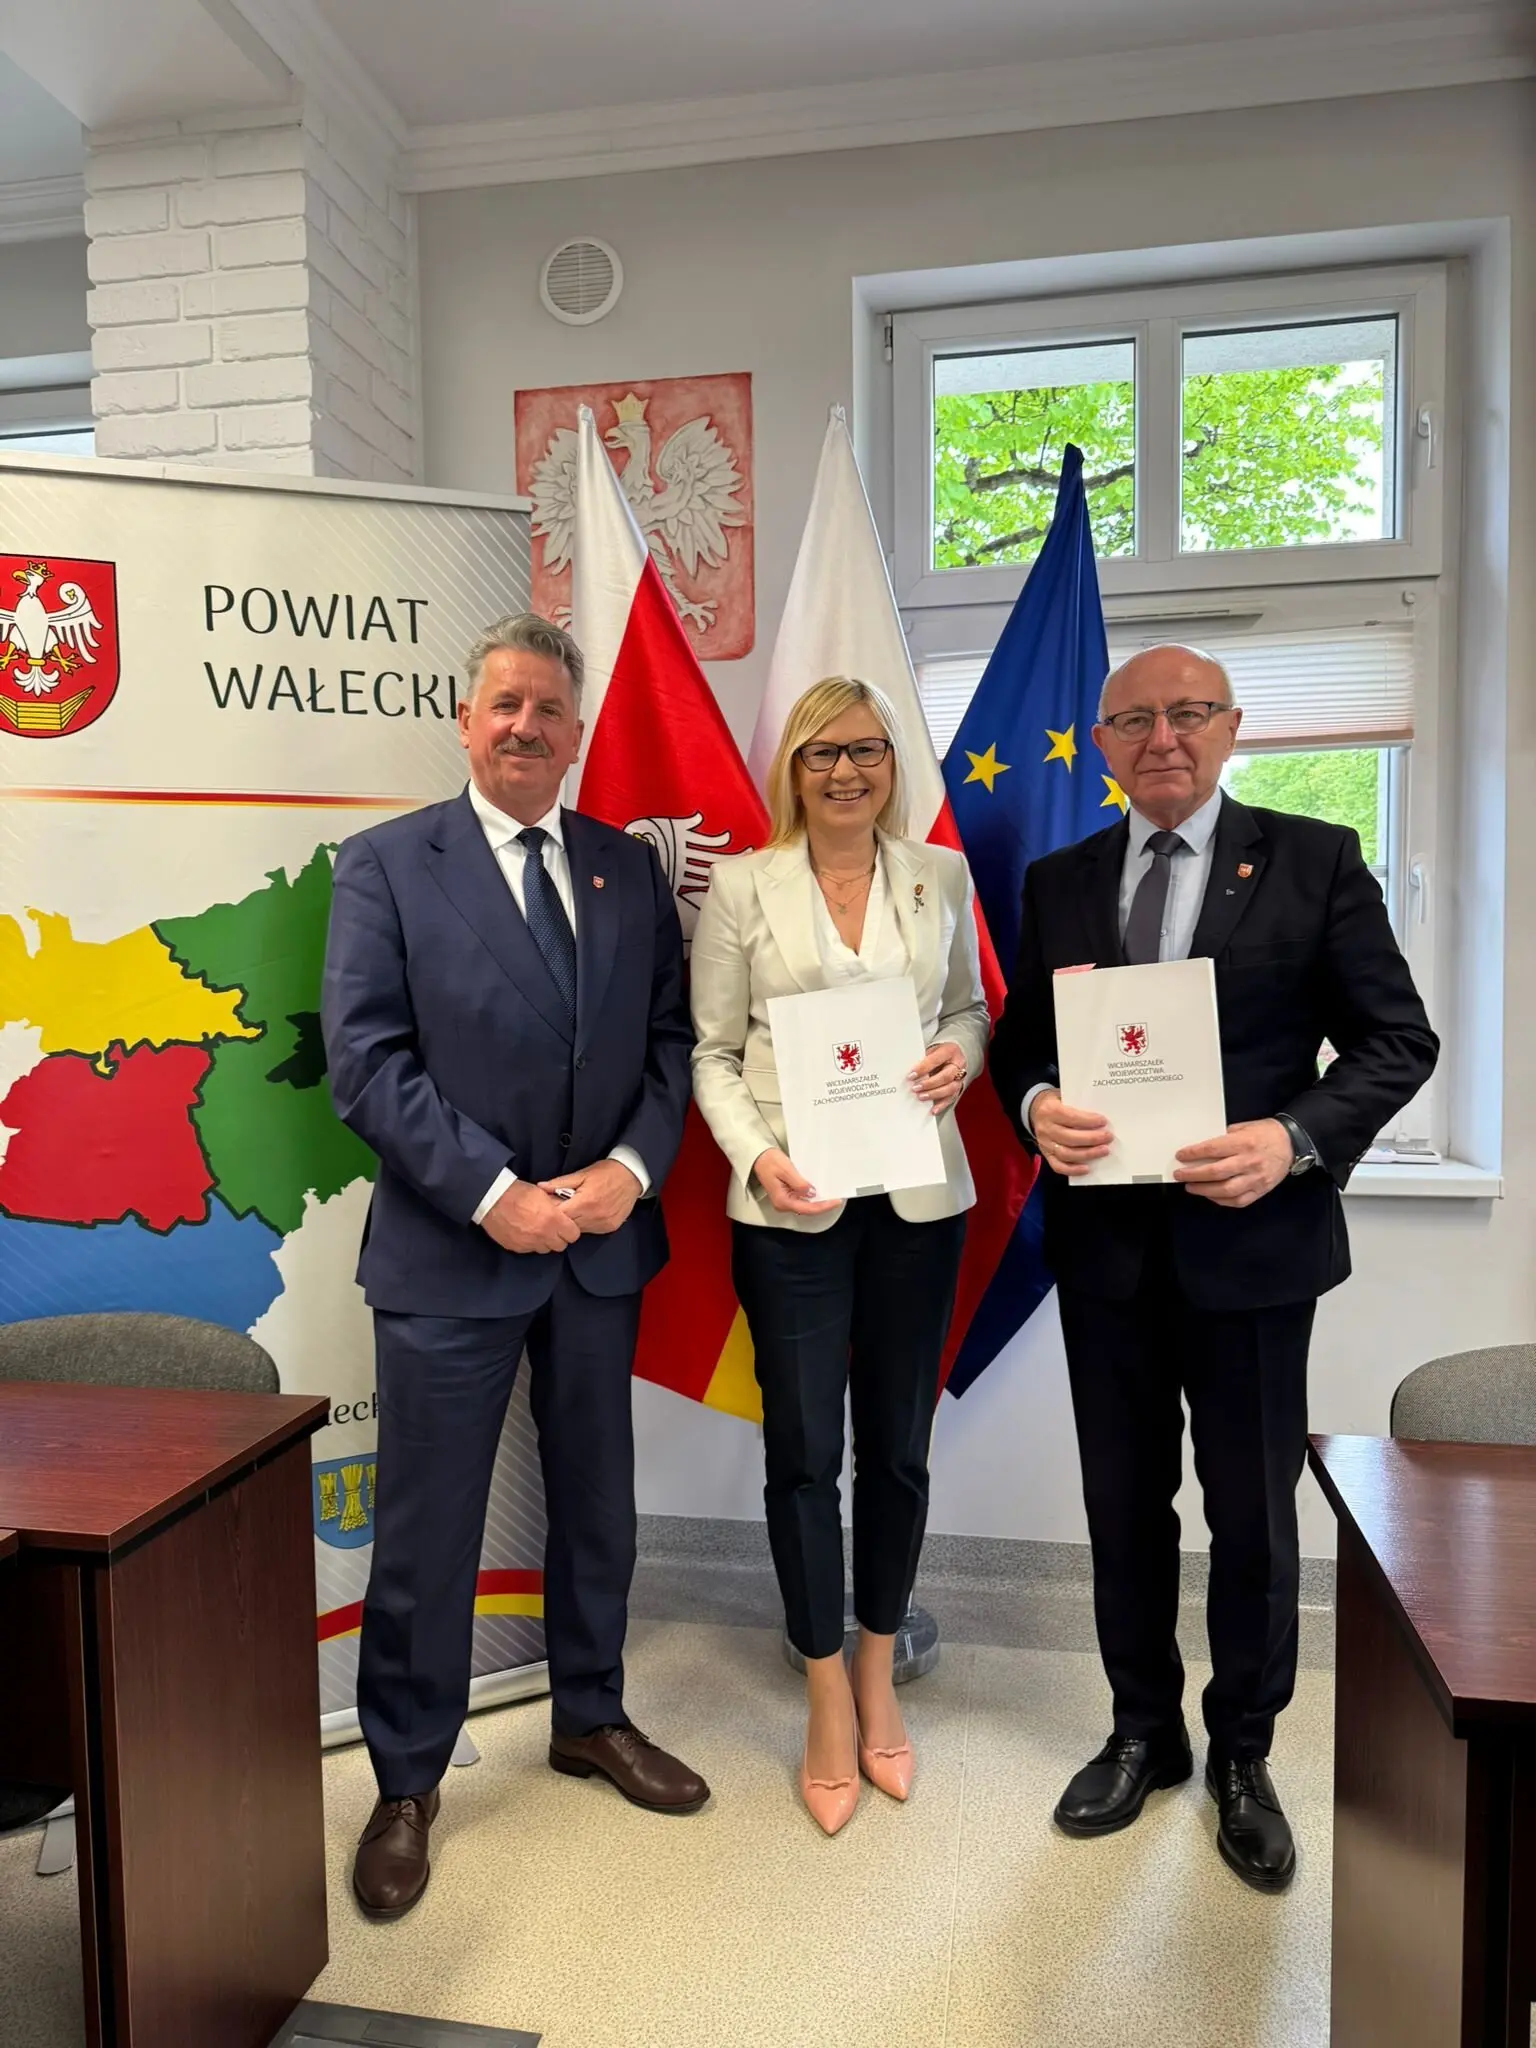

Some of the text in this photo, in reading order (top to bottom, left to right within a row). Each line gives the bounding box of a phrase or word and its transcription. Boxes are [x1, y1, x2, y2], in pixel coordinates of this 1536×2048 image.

[204, 585, 428, 643] POWIAT
[203, 661, 457, 720] WAŁECKI
[1107, 1059, 1164, 1069] WICEMARSZAŁEK
[825, 1074, 879, 1087] WICEMARSZAŁEK
[1092, 1074, 1184, 1087] ZACHODNIOPOMORSKIEGO
[813, 1087, 897, 1106] ZACHODNIOPOMORSKIEGO
